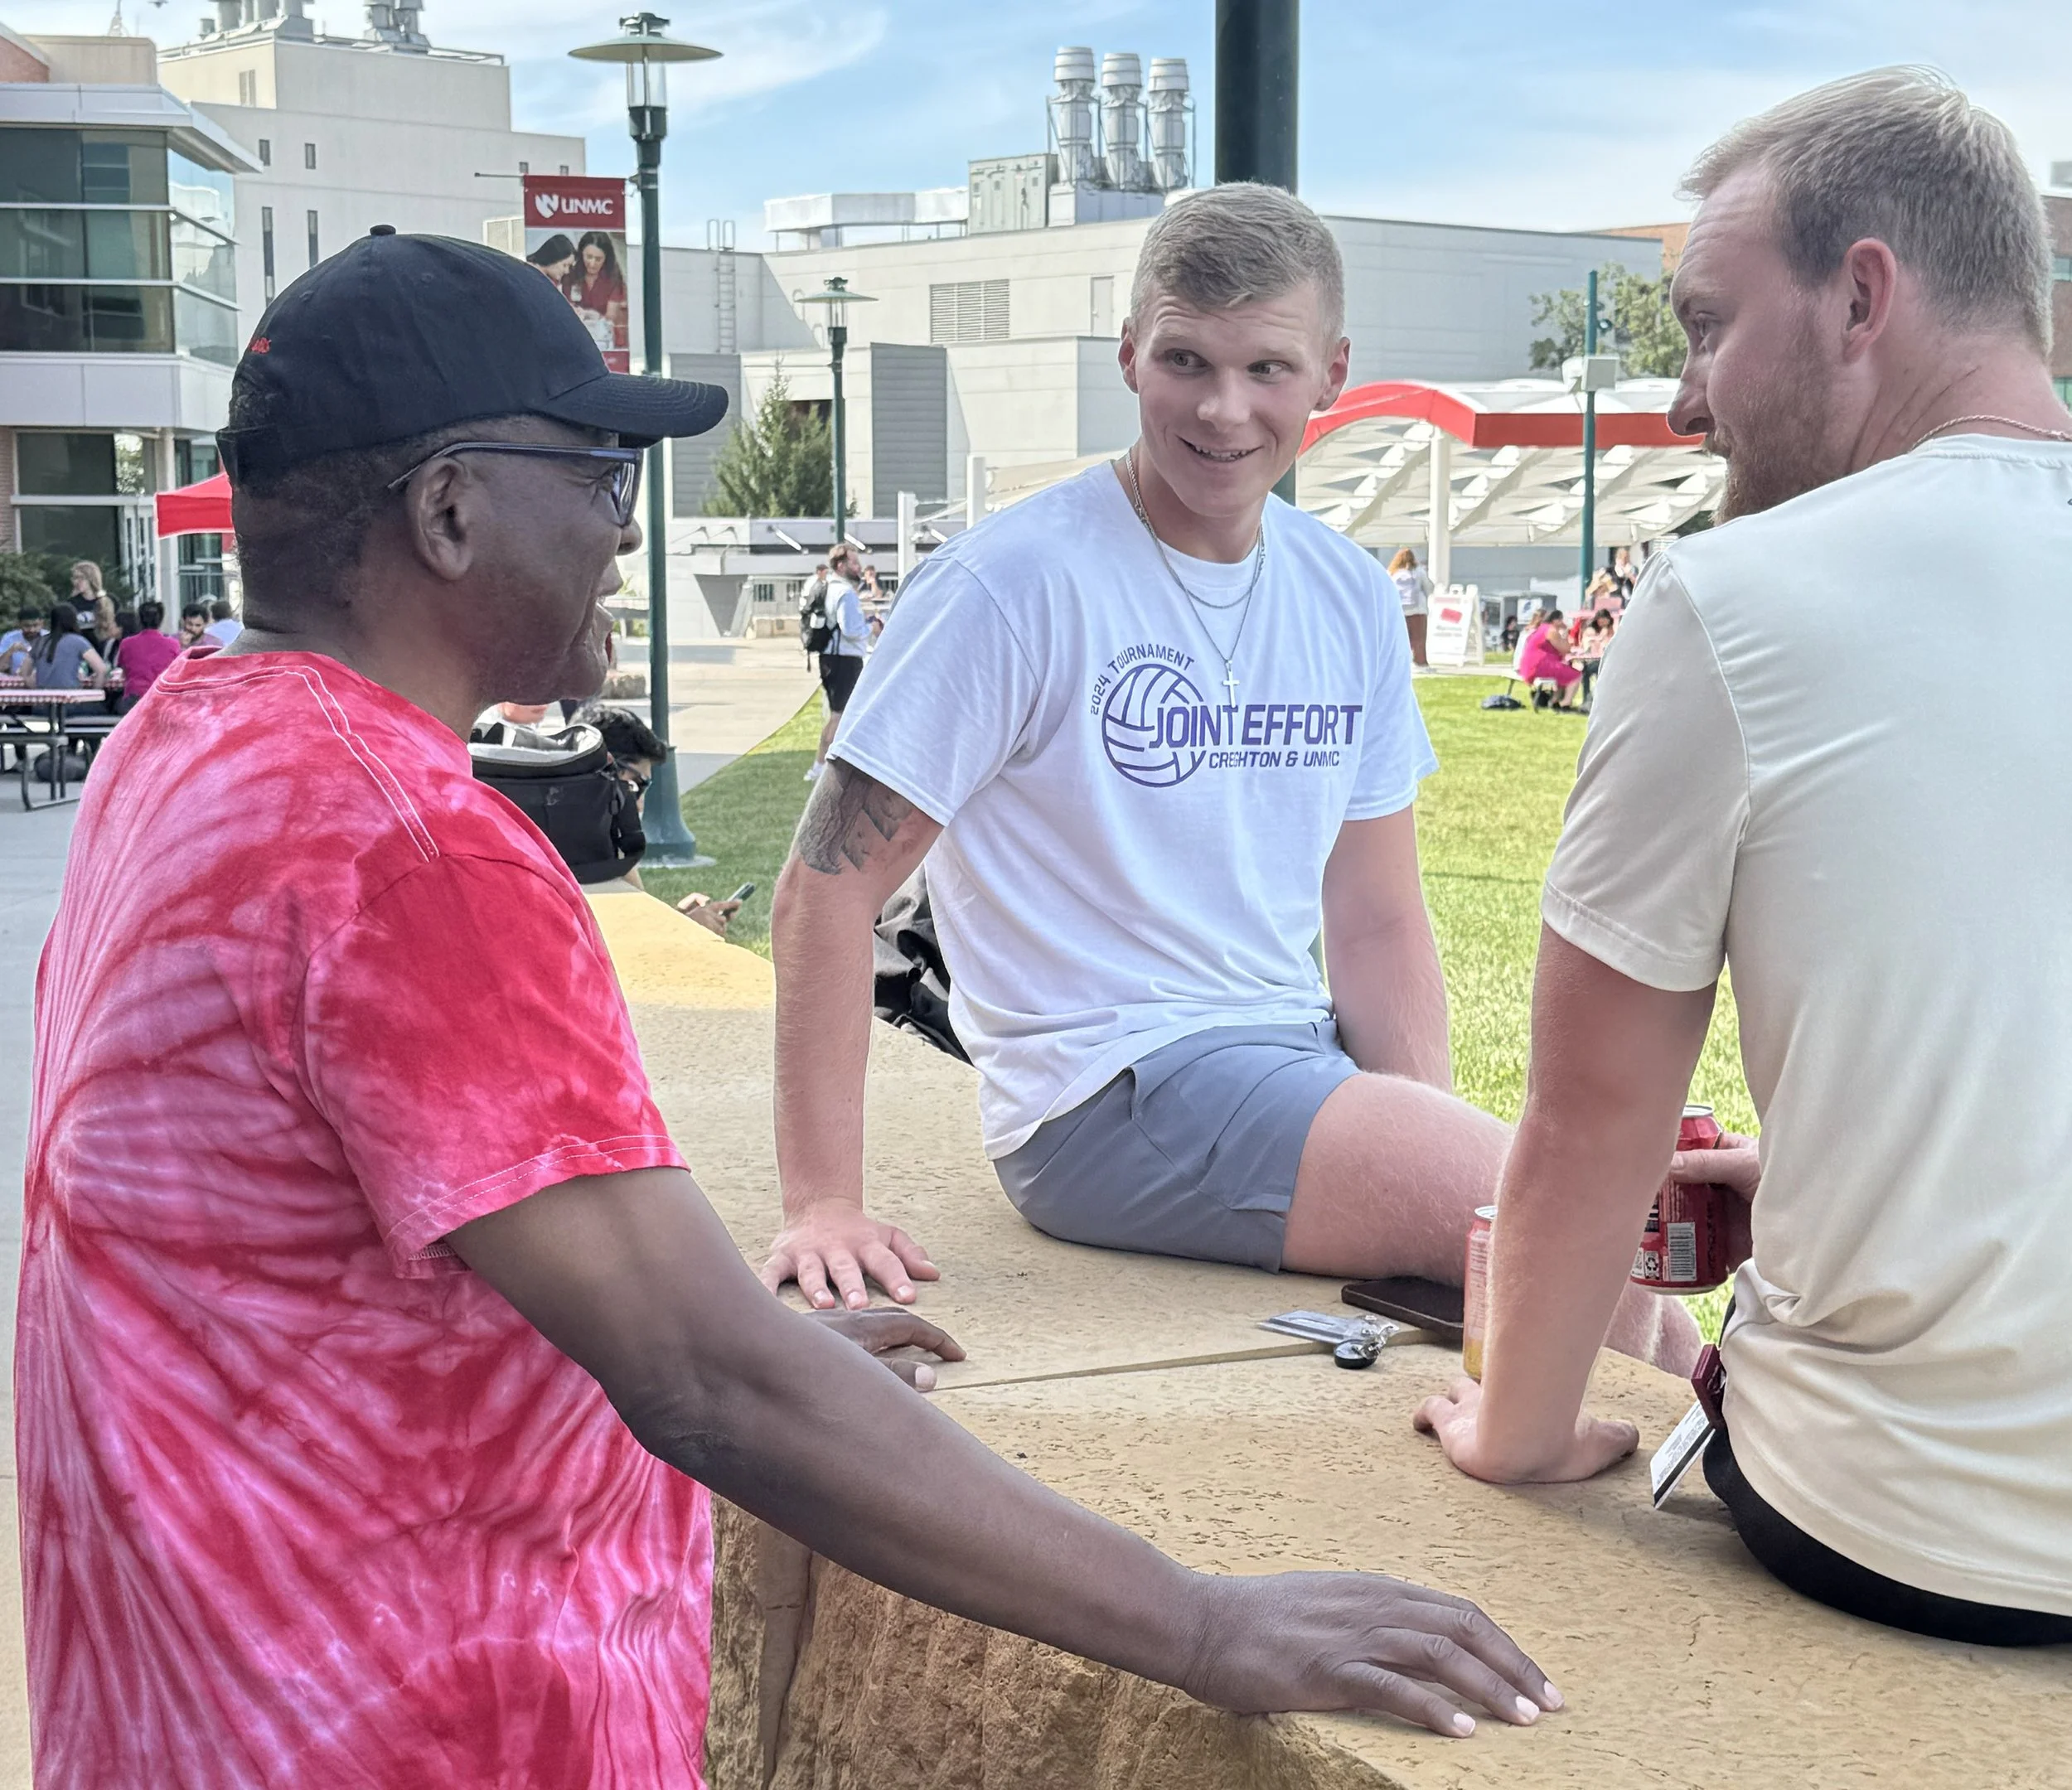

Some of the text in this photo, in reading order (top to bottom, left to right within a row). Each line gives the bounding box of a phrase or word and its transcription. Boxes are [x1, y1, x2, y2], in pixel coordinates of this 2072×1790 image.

[561, 197, 613, 215] UNMC
[1091, 643, 1194, 715] 2024 TOURNAMENT
[1149, 704, 1363, 748] JOINT EFFORT
[1209, 751, 1339, 768] CREGHTON & UNMC
